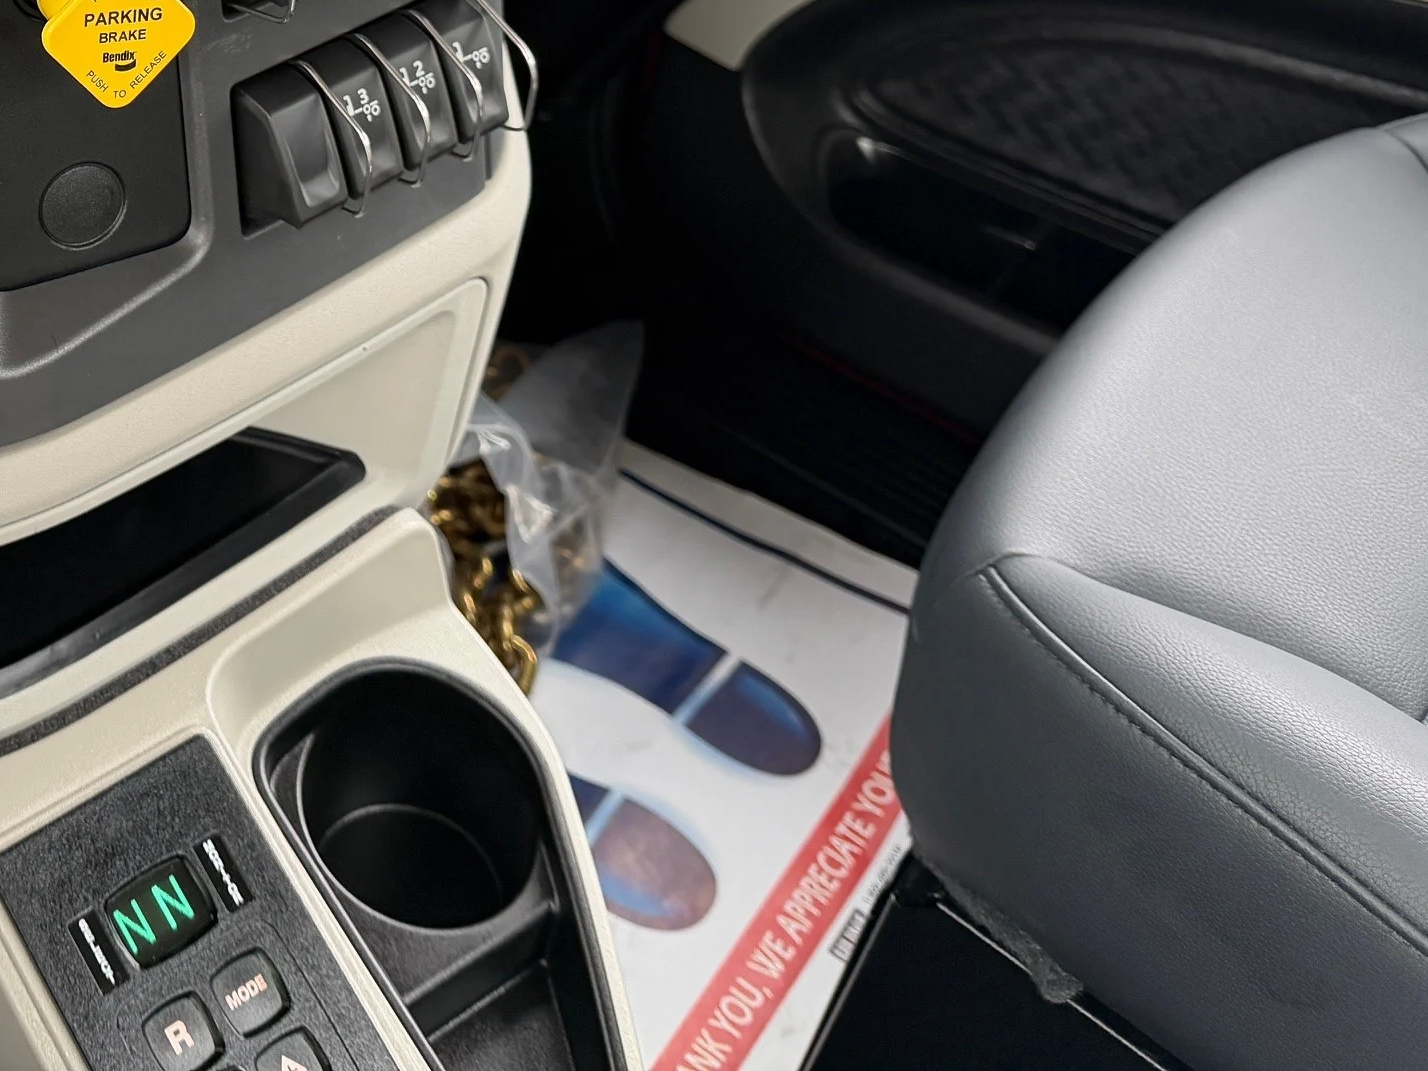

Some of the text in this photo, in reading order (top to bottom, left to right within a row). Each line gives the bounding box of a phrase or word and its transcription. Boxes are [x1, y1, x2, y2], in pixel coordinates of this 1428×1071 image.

[84, 7, 163, 27] PARKING
[99, 29, 146, 44] BRAKE
[86, 50, 167, 99] PUSH TO RELEASE
[102, 50, 136, 63] Bendix
[745, 930, 797, 979] WE
[776, 810, 876, 945] APPRECIATE
[225, 973, 268, 1011] MODE
[164, 1019, 194, 1056] R
